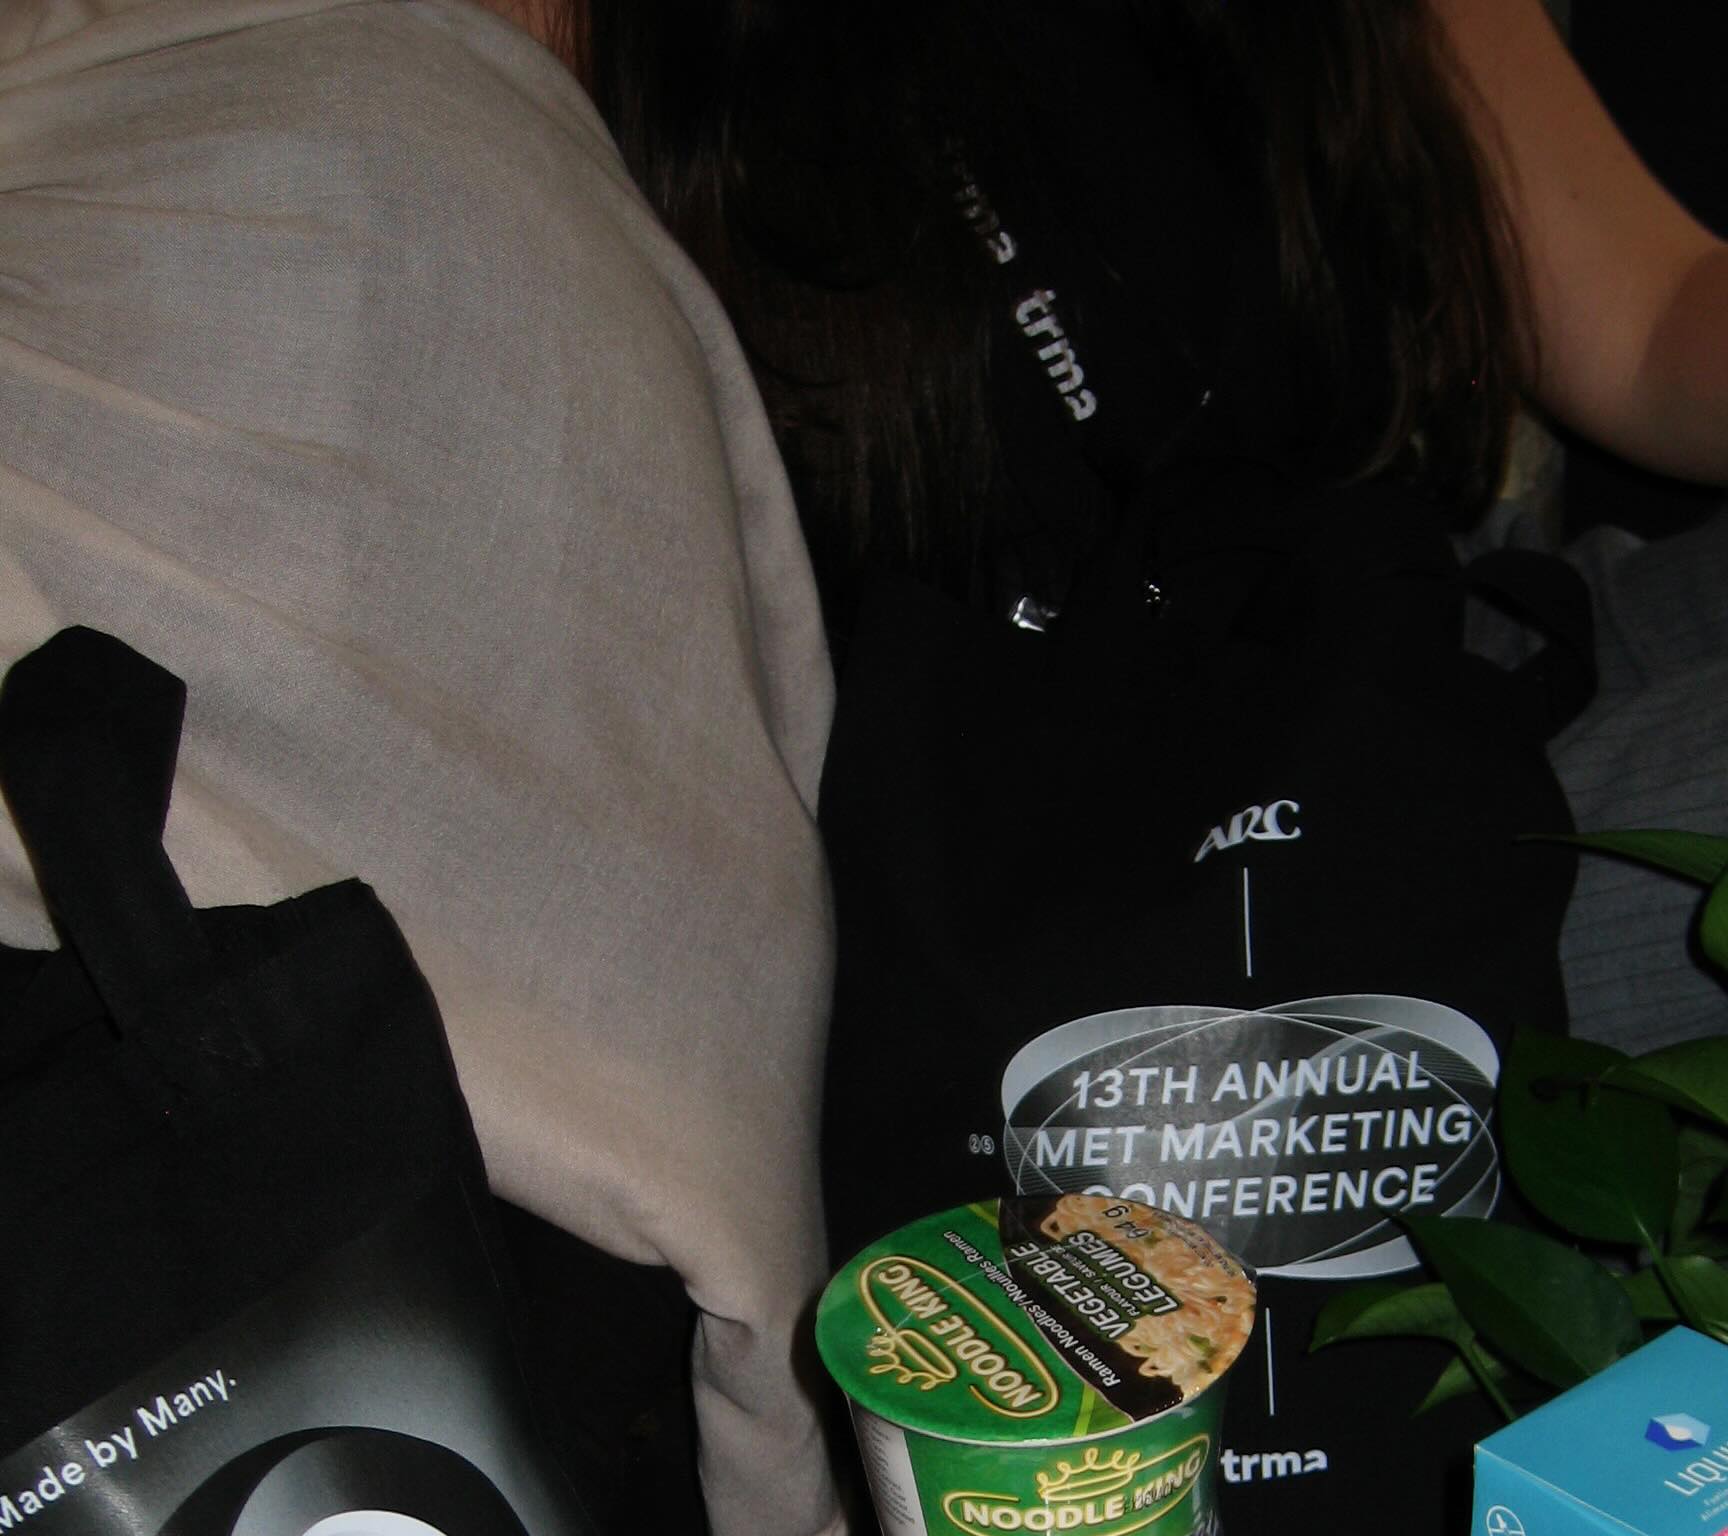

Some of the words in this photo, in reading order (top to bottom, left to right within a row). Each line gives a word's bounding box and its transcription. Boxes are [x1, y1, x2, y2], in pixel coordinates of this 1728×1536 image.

[1016, 290, 1097, 421] trma
[1194, 800, 1301, 863] ARC
[1071, 1068, 1198, 1110] 13TH
[1211, 1050, 1431, 1103] ANNUAL
[1036, 1123, 1147, 1168] MET
[1160, 1103, 1473, 1163] MARKETING
[944, 1231, 983, 1263] Ramen
[1068, 1231, 1179, 1313] LÉGUMES
[877, 1264, 948, 1321] KING
[976, 1259, 1027, 1308] Nouilles
[1011, 1243, 1131, 1338] VEGETABLE
[1100, 1284, 1140, 1316] FLAVOUR
[1027, 1304, 1079, 1349] Noodles
[928, 1313, 1043, 1408] NOODLE
[1074, 1345, 1121, 1387] Ramen
[0, 1466, 85, 1534] Made
[84, 1427, 138, 1467] by
[136, 1370, 237, 1436] Many.
[962, 1494, 1125, 1532] NOODLE
